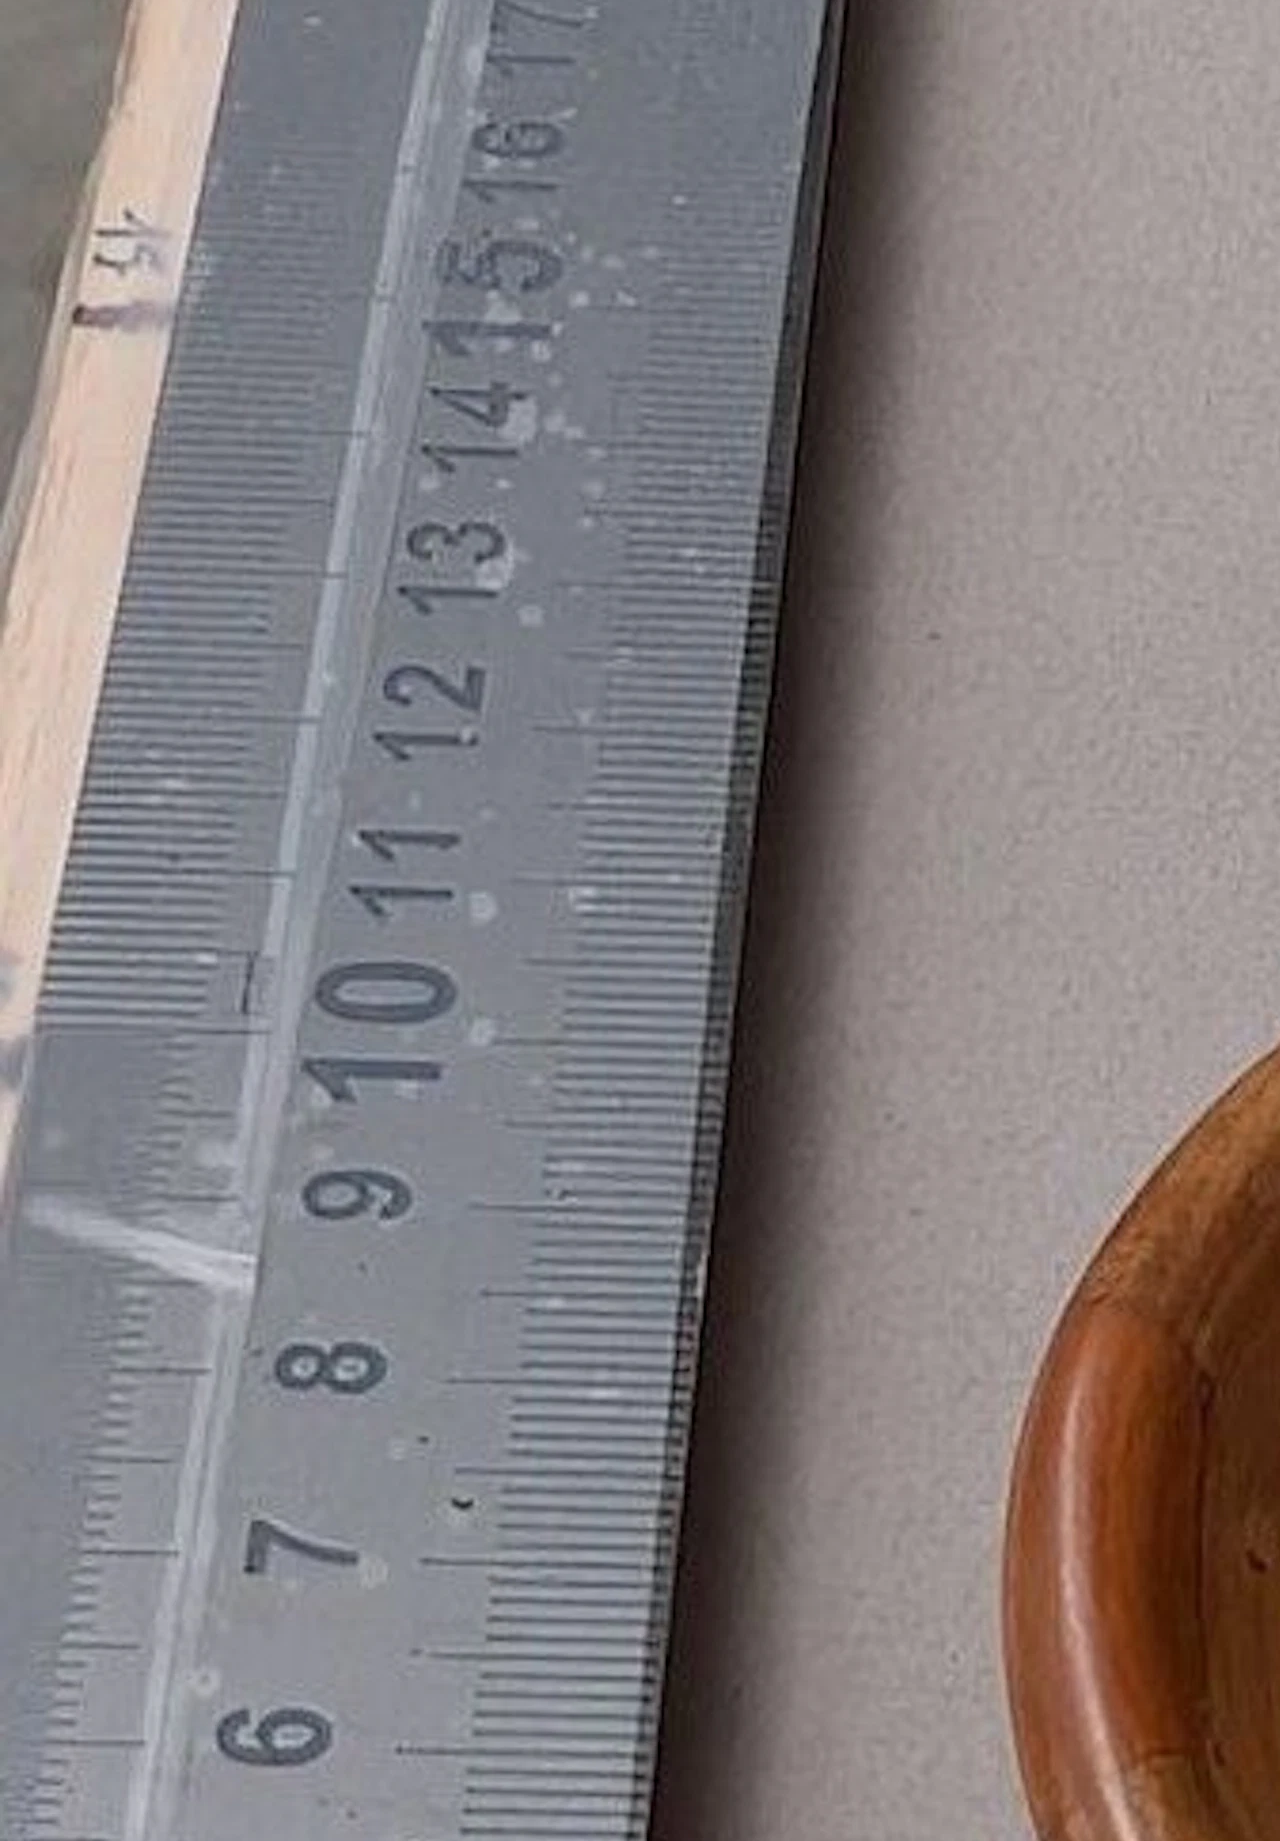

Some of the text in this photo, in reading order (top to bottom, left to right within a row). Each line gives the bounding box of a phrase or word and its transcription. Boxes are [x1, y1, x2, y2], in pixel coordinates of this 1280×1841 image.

[462, 121, 562, 203] 16
[421, 240, 563, 357] 15
[420, 381, 528, 474] 14
[397, 522, 507, 615] 13
[373, 665, 486, 761] 12
[349, 829, 461, 917] 11
[301, 962, 457, 1103] 10
[302, 1170, 412, 1221] 9
[273, 1342, 387, 1394] 8
[243, 1519, 359, 1576] 7
[216, 1708, 332, 1767] 6
